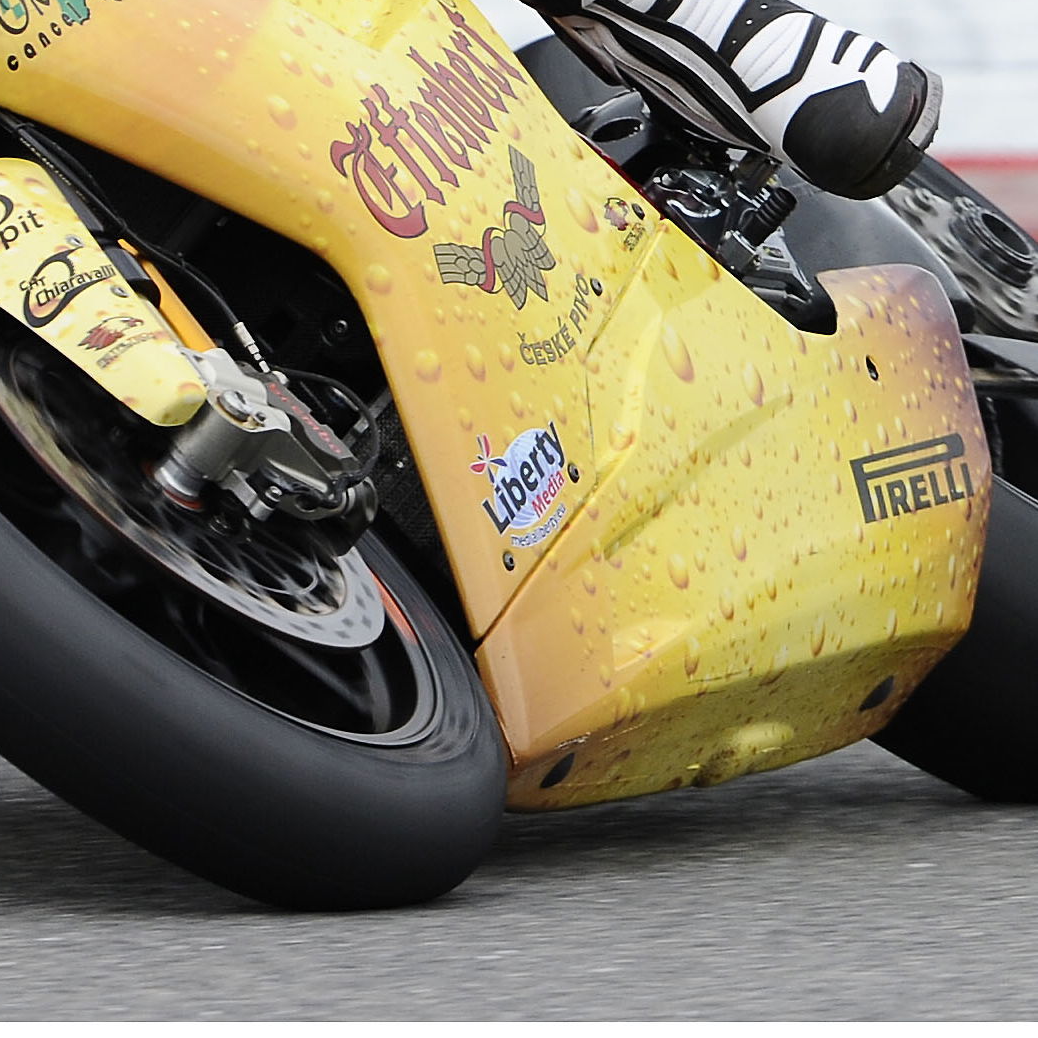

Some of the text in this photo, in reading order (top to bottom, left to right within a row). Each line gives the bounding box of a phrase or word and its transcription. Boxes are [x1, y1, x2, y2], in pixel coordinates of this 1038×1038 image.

[35, 263, 117, 307] Chiaravalli
[517, 273, 591, 366] ČESKÉ PIVO
[481, 421, 565, 535] Liberty
[531, 471, 565, 518] Media
[850, 432, 974, 524] PIRELLI
